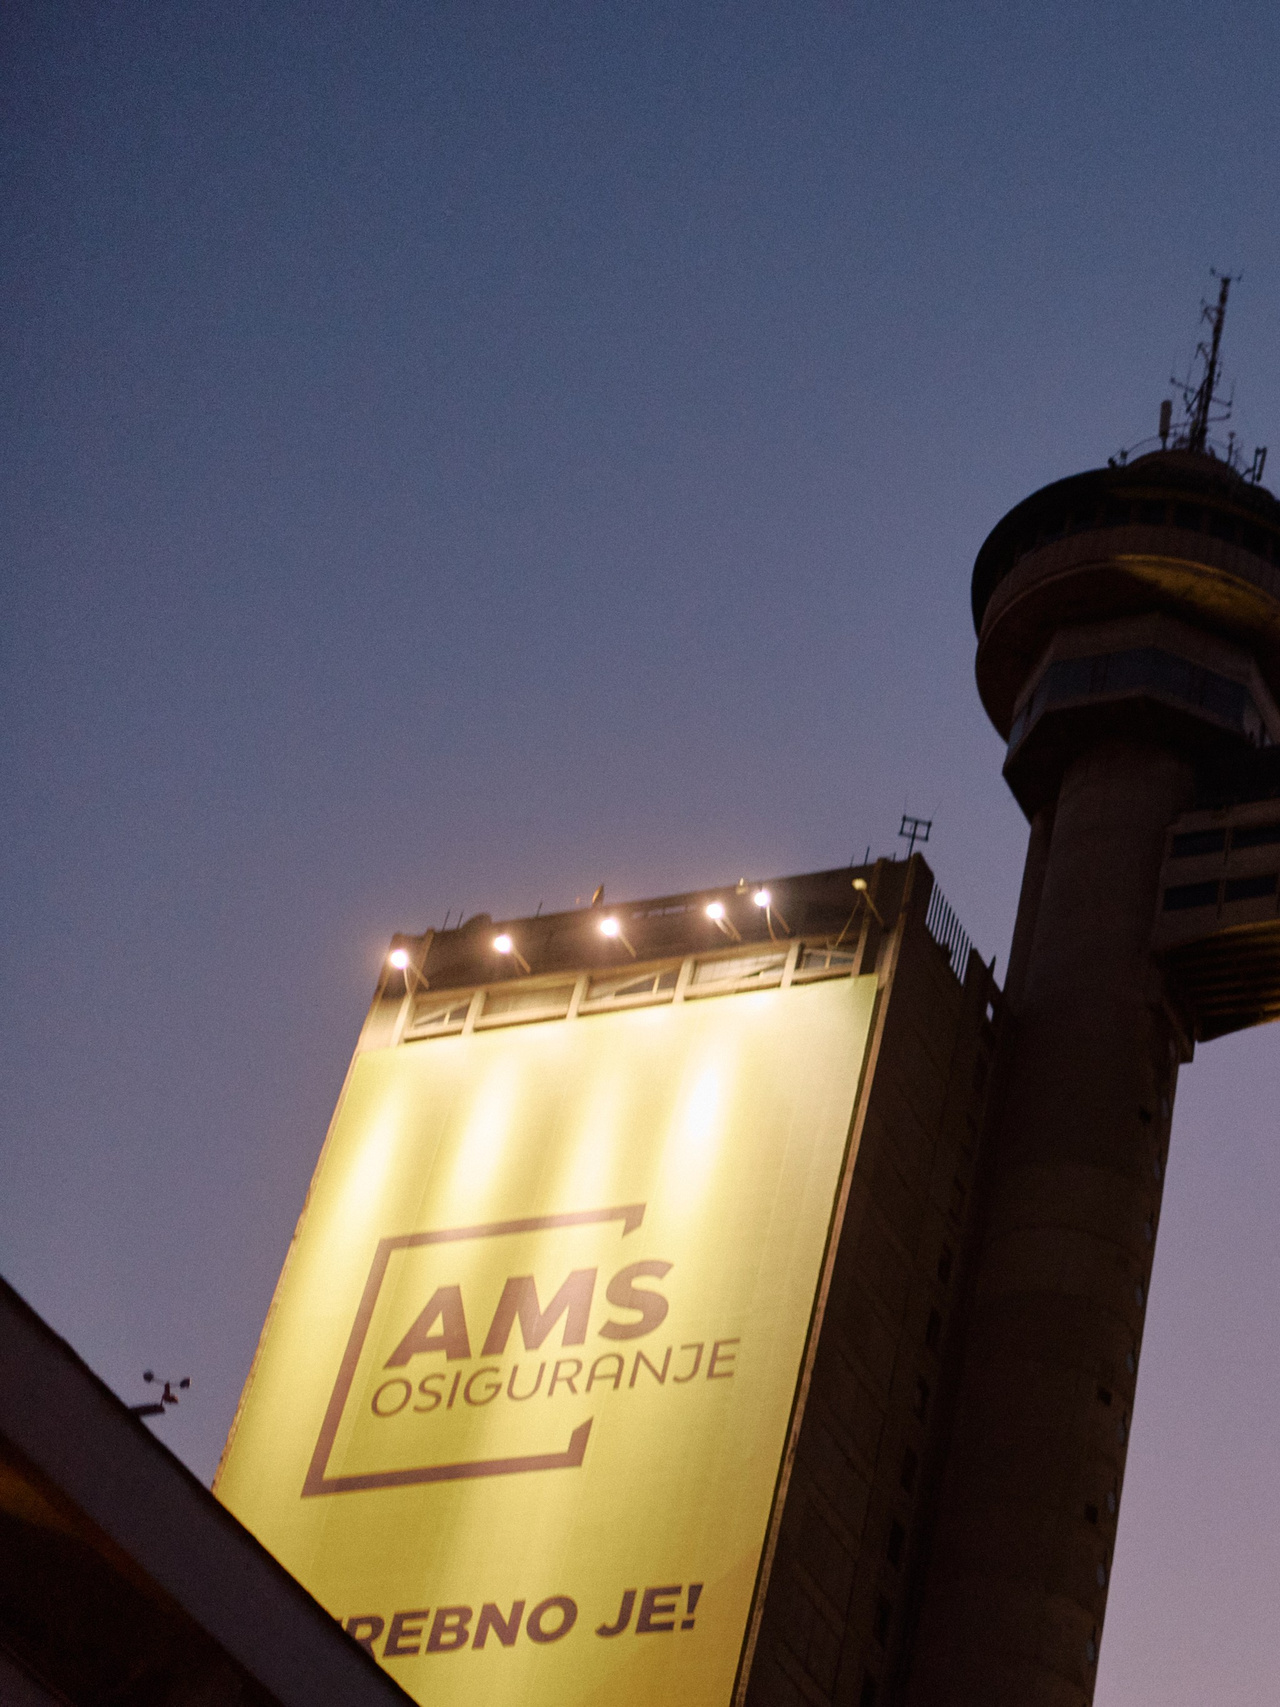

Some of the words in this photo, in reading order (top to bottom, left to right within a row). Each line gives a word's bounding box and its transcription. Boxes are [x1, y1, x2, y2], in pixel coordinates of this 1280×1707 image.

[383, 1259, 674, 1370] AMS
[370, 1338, 741, 1418] OSIGURANJE
[335, 1595, 578, 1660] REBNO
[595, 1583, 704, 1638] JE!
